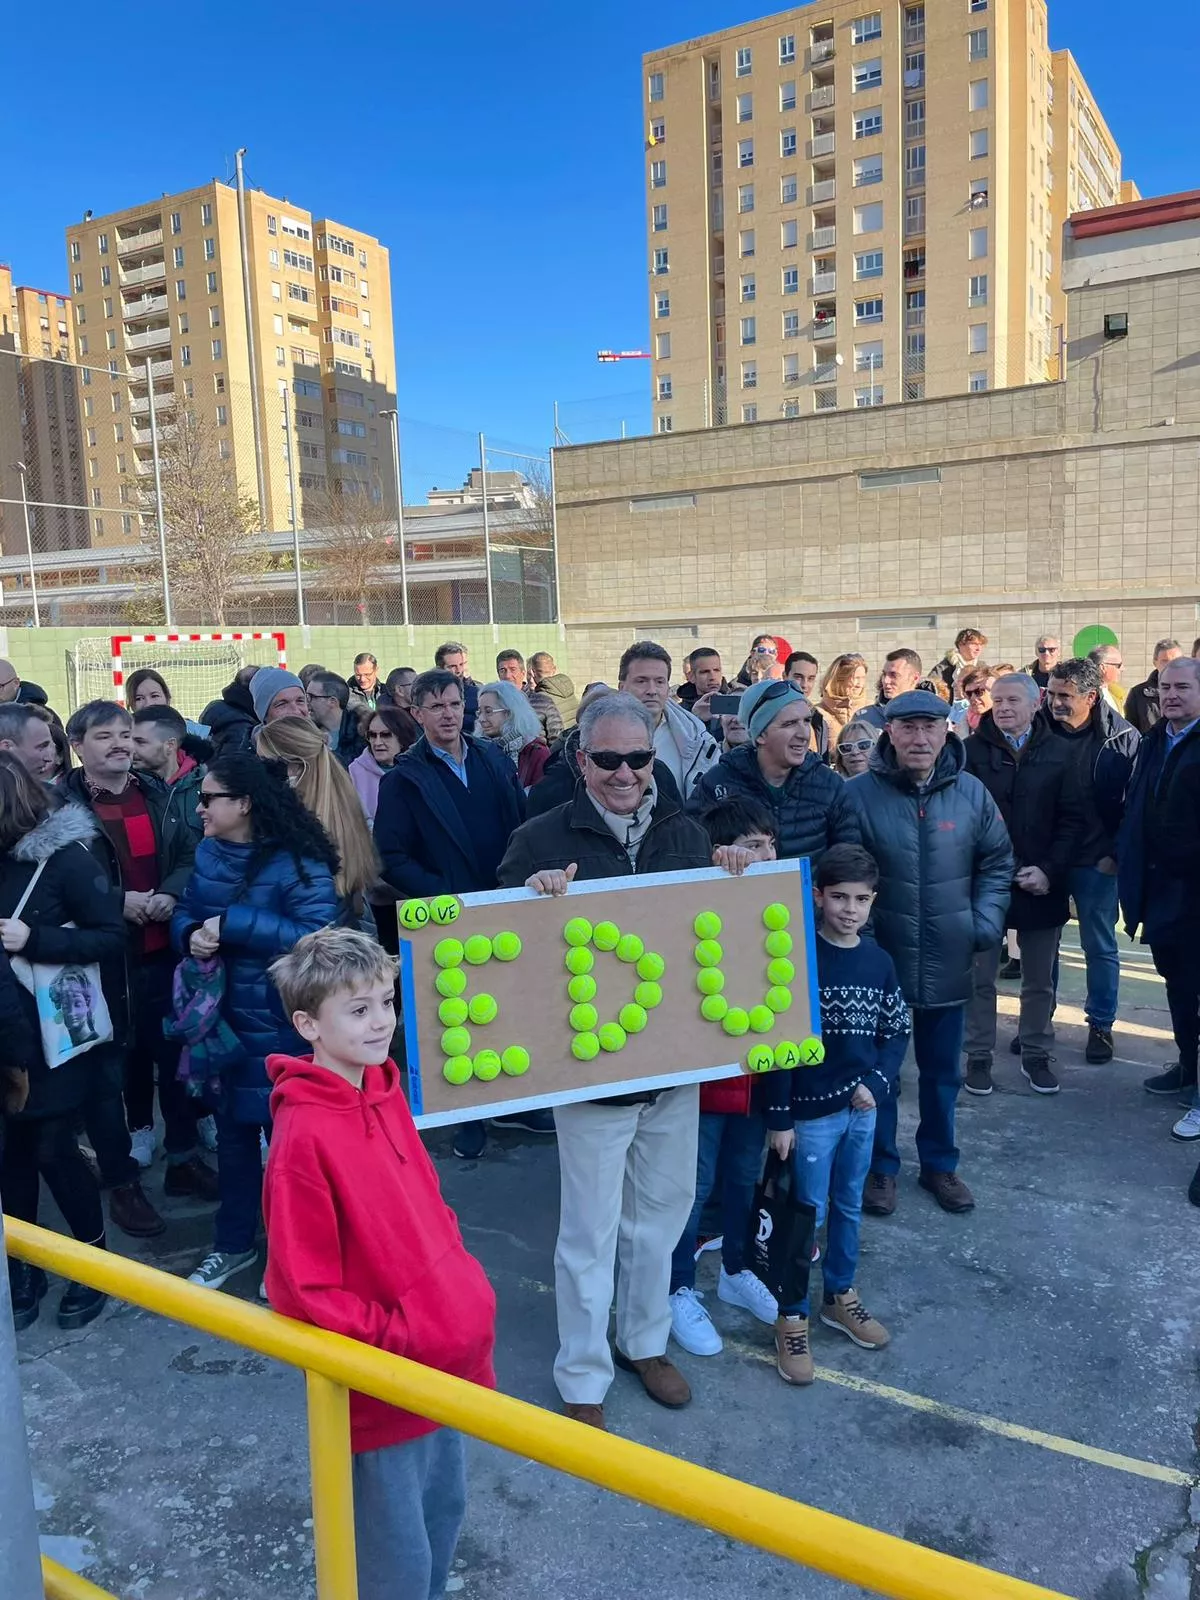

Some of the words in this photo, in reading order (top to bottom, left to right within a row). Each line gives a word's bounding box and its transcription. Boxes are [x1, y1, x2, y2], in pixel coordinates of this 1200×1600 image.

[404, 904, 456, 922] LOVE
[434, 902, 796, 1085] EDU
[757, 1047, 819, 1070] MAX
